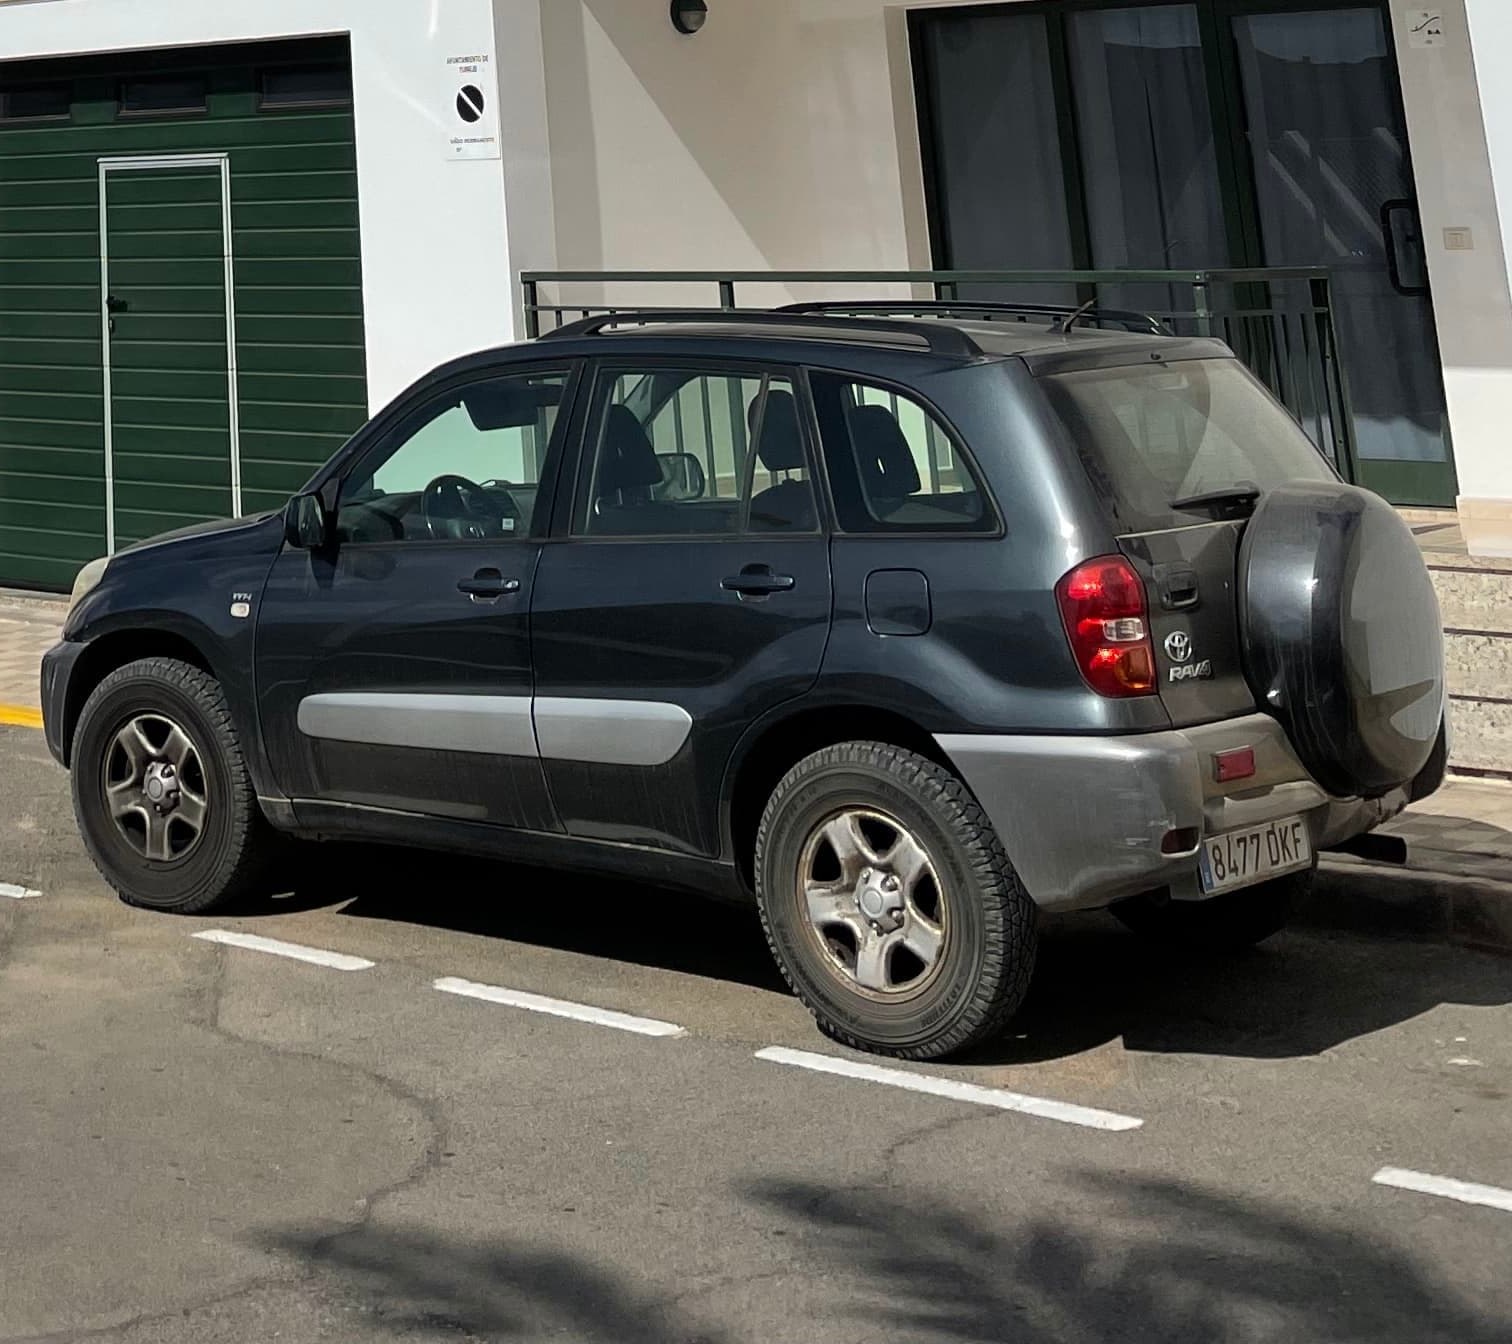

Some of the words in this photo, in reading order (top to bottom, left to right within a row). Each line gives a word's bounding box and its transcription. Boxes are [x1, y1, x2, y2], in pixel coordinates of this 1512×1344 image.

[1169, 660, 1213, 682] RAV4
[1211, 833, 1261, 880] 8477
[1266, 821, 1302, 866] DKF
